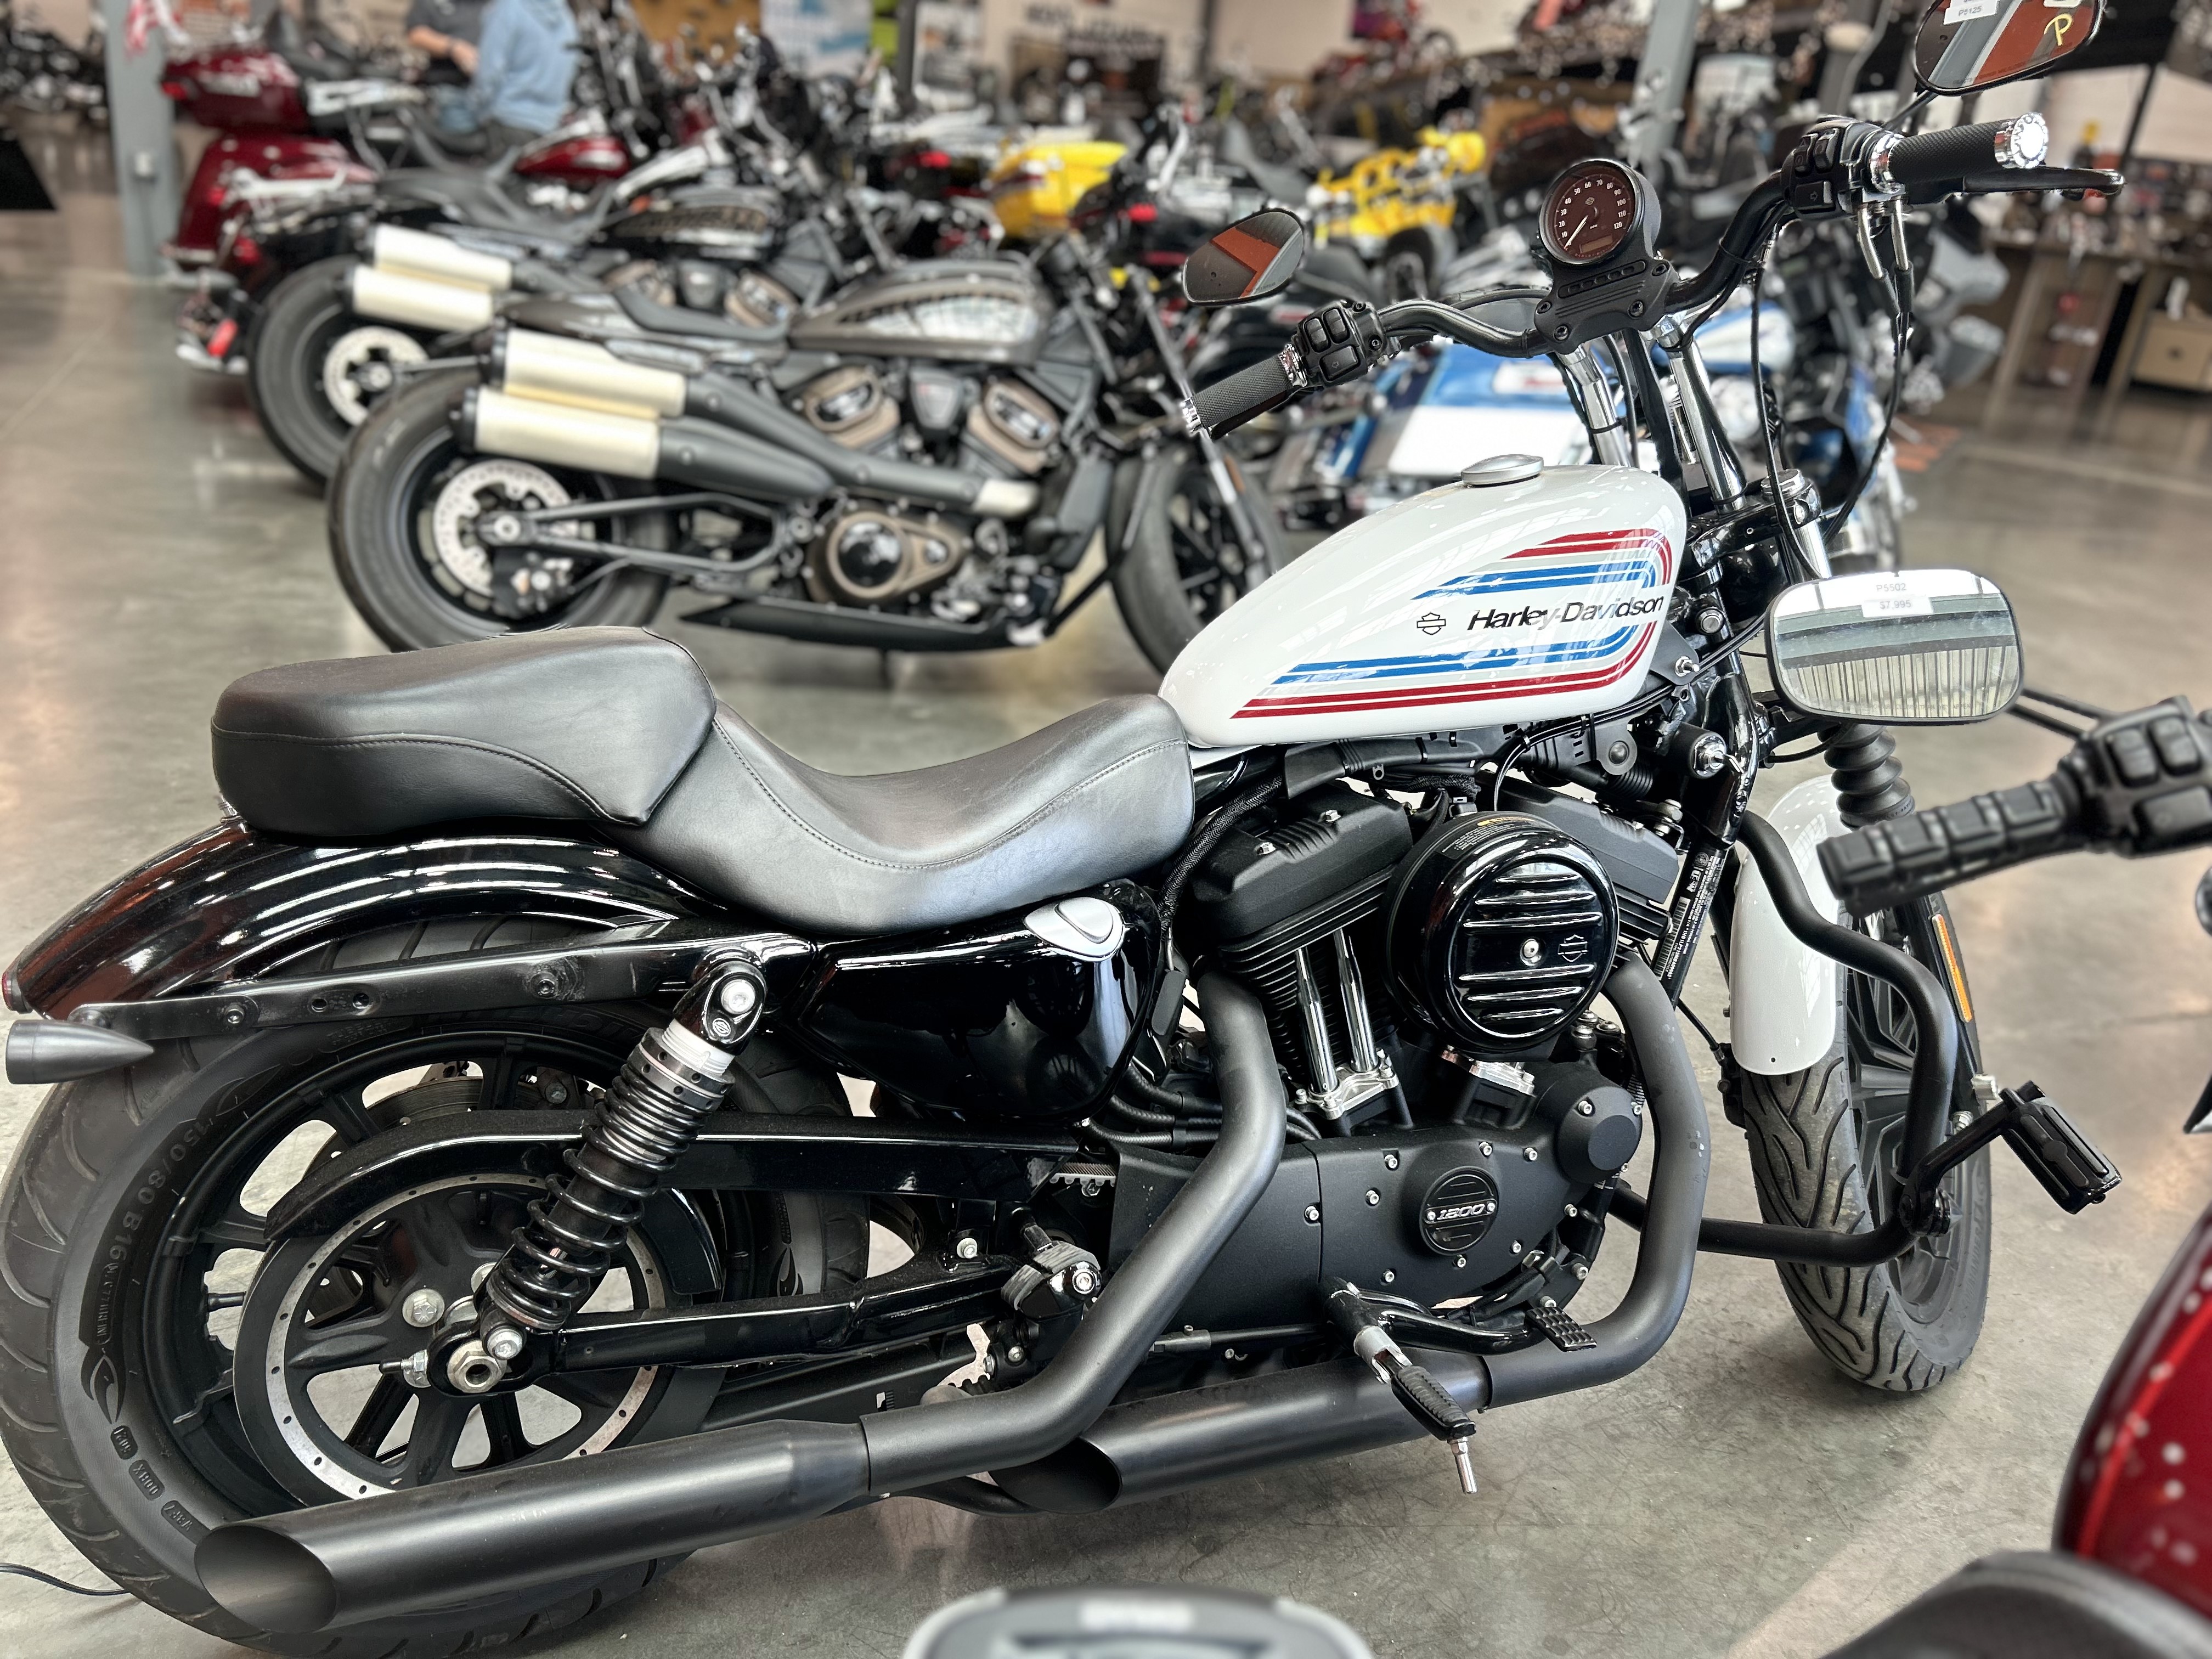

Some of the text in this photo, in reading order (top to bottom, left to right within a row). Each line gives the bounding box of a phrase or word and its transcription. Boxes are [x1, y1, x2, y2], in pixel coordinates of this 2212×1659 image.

[2044, 13, 2073, 46] P
[1617, 198, 1626, 206] 100
[1876, 583, 1907, 592] P5502
[1880, 599, 1911, 610] $7,995
[1466, 595, 1664, 632] Harley-Davidson
[136, 1118, 211, 1205] 150/80
[1436, 1204, 1486, 1220] 1200
